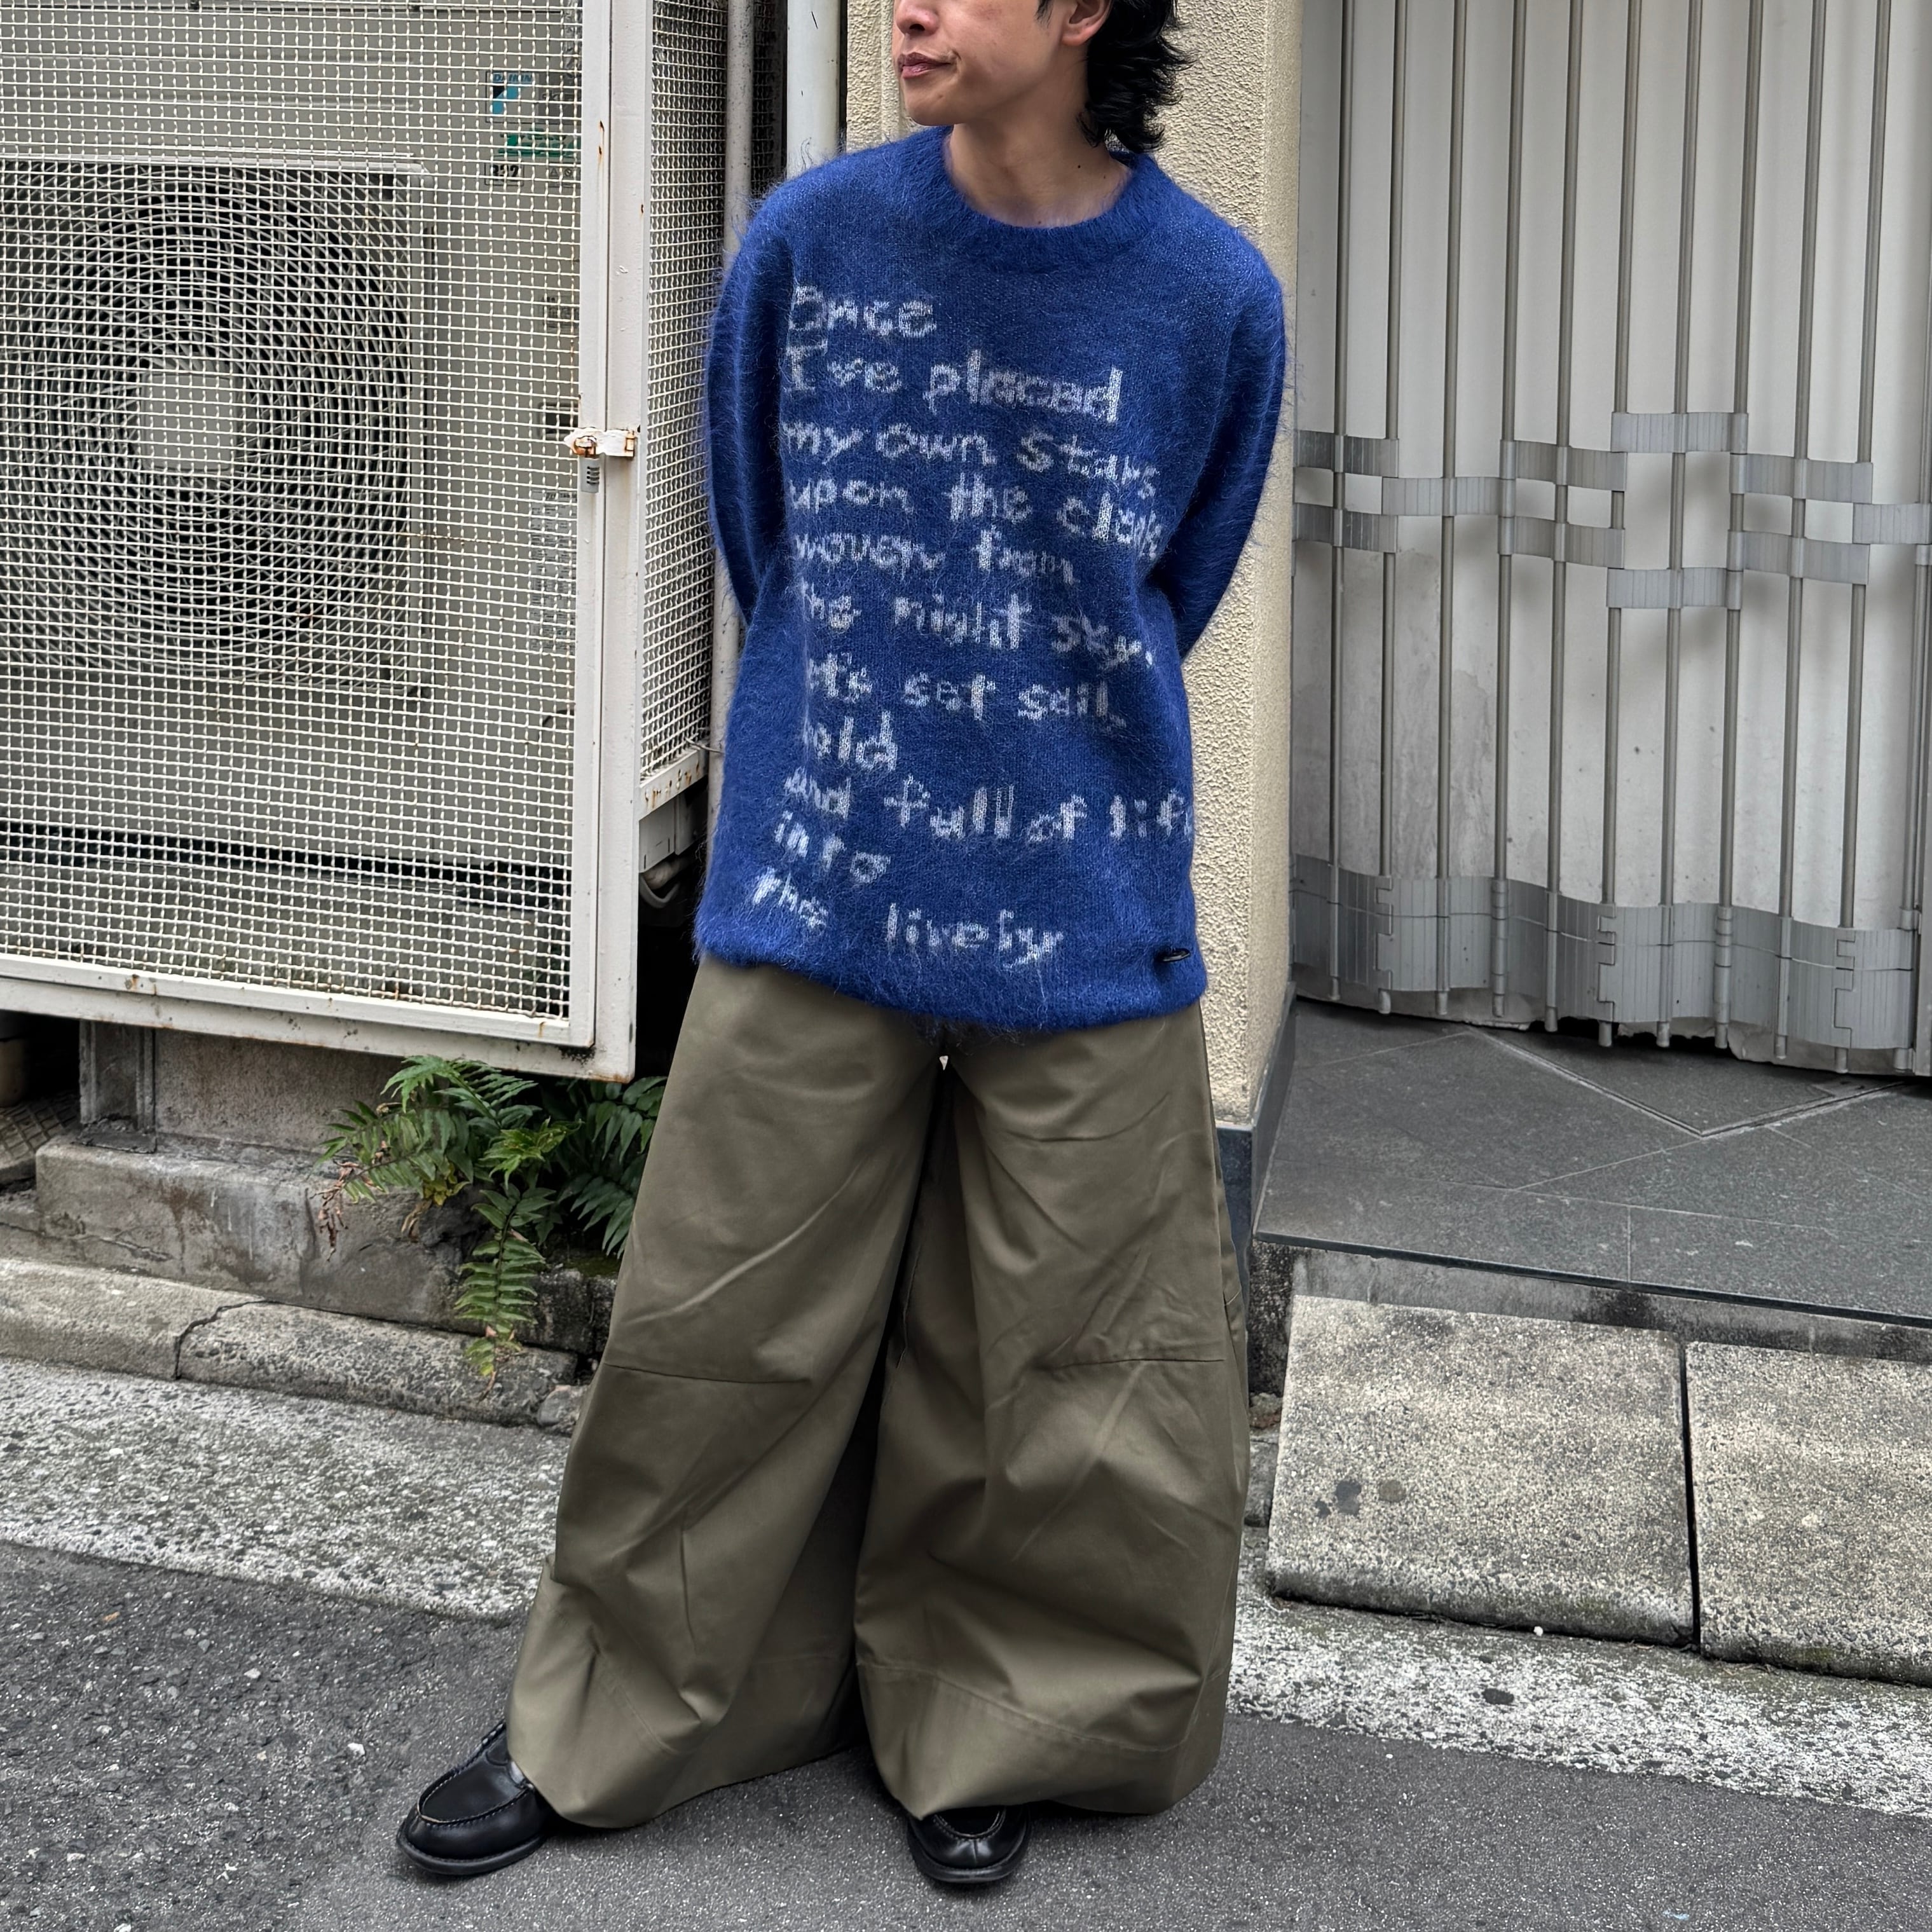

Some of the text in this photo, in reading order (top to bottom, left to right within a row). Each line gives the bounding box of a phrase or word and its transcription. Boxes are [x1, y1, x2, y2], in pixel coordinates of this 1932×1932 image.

[493, 72, 533, 83] DIKIN
[788, 285, 937, 338] Once
[922, 348, 1123, 423] placed
[783, 421, 870, 465] my
[876, 422, 997, 465] own
[790, 478, 914, 515] upon
[942, 472, 1034, 524] the
[904, 671, 996, 721] set
[883, 773, 1015, 840] full
[1109, 790, 1194, 840] lif
